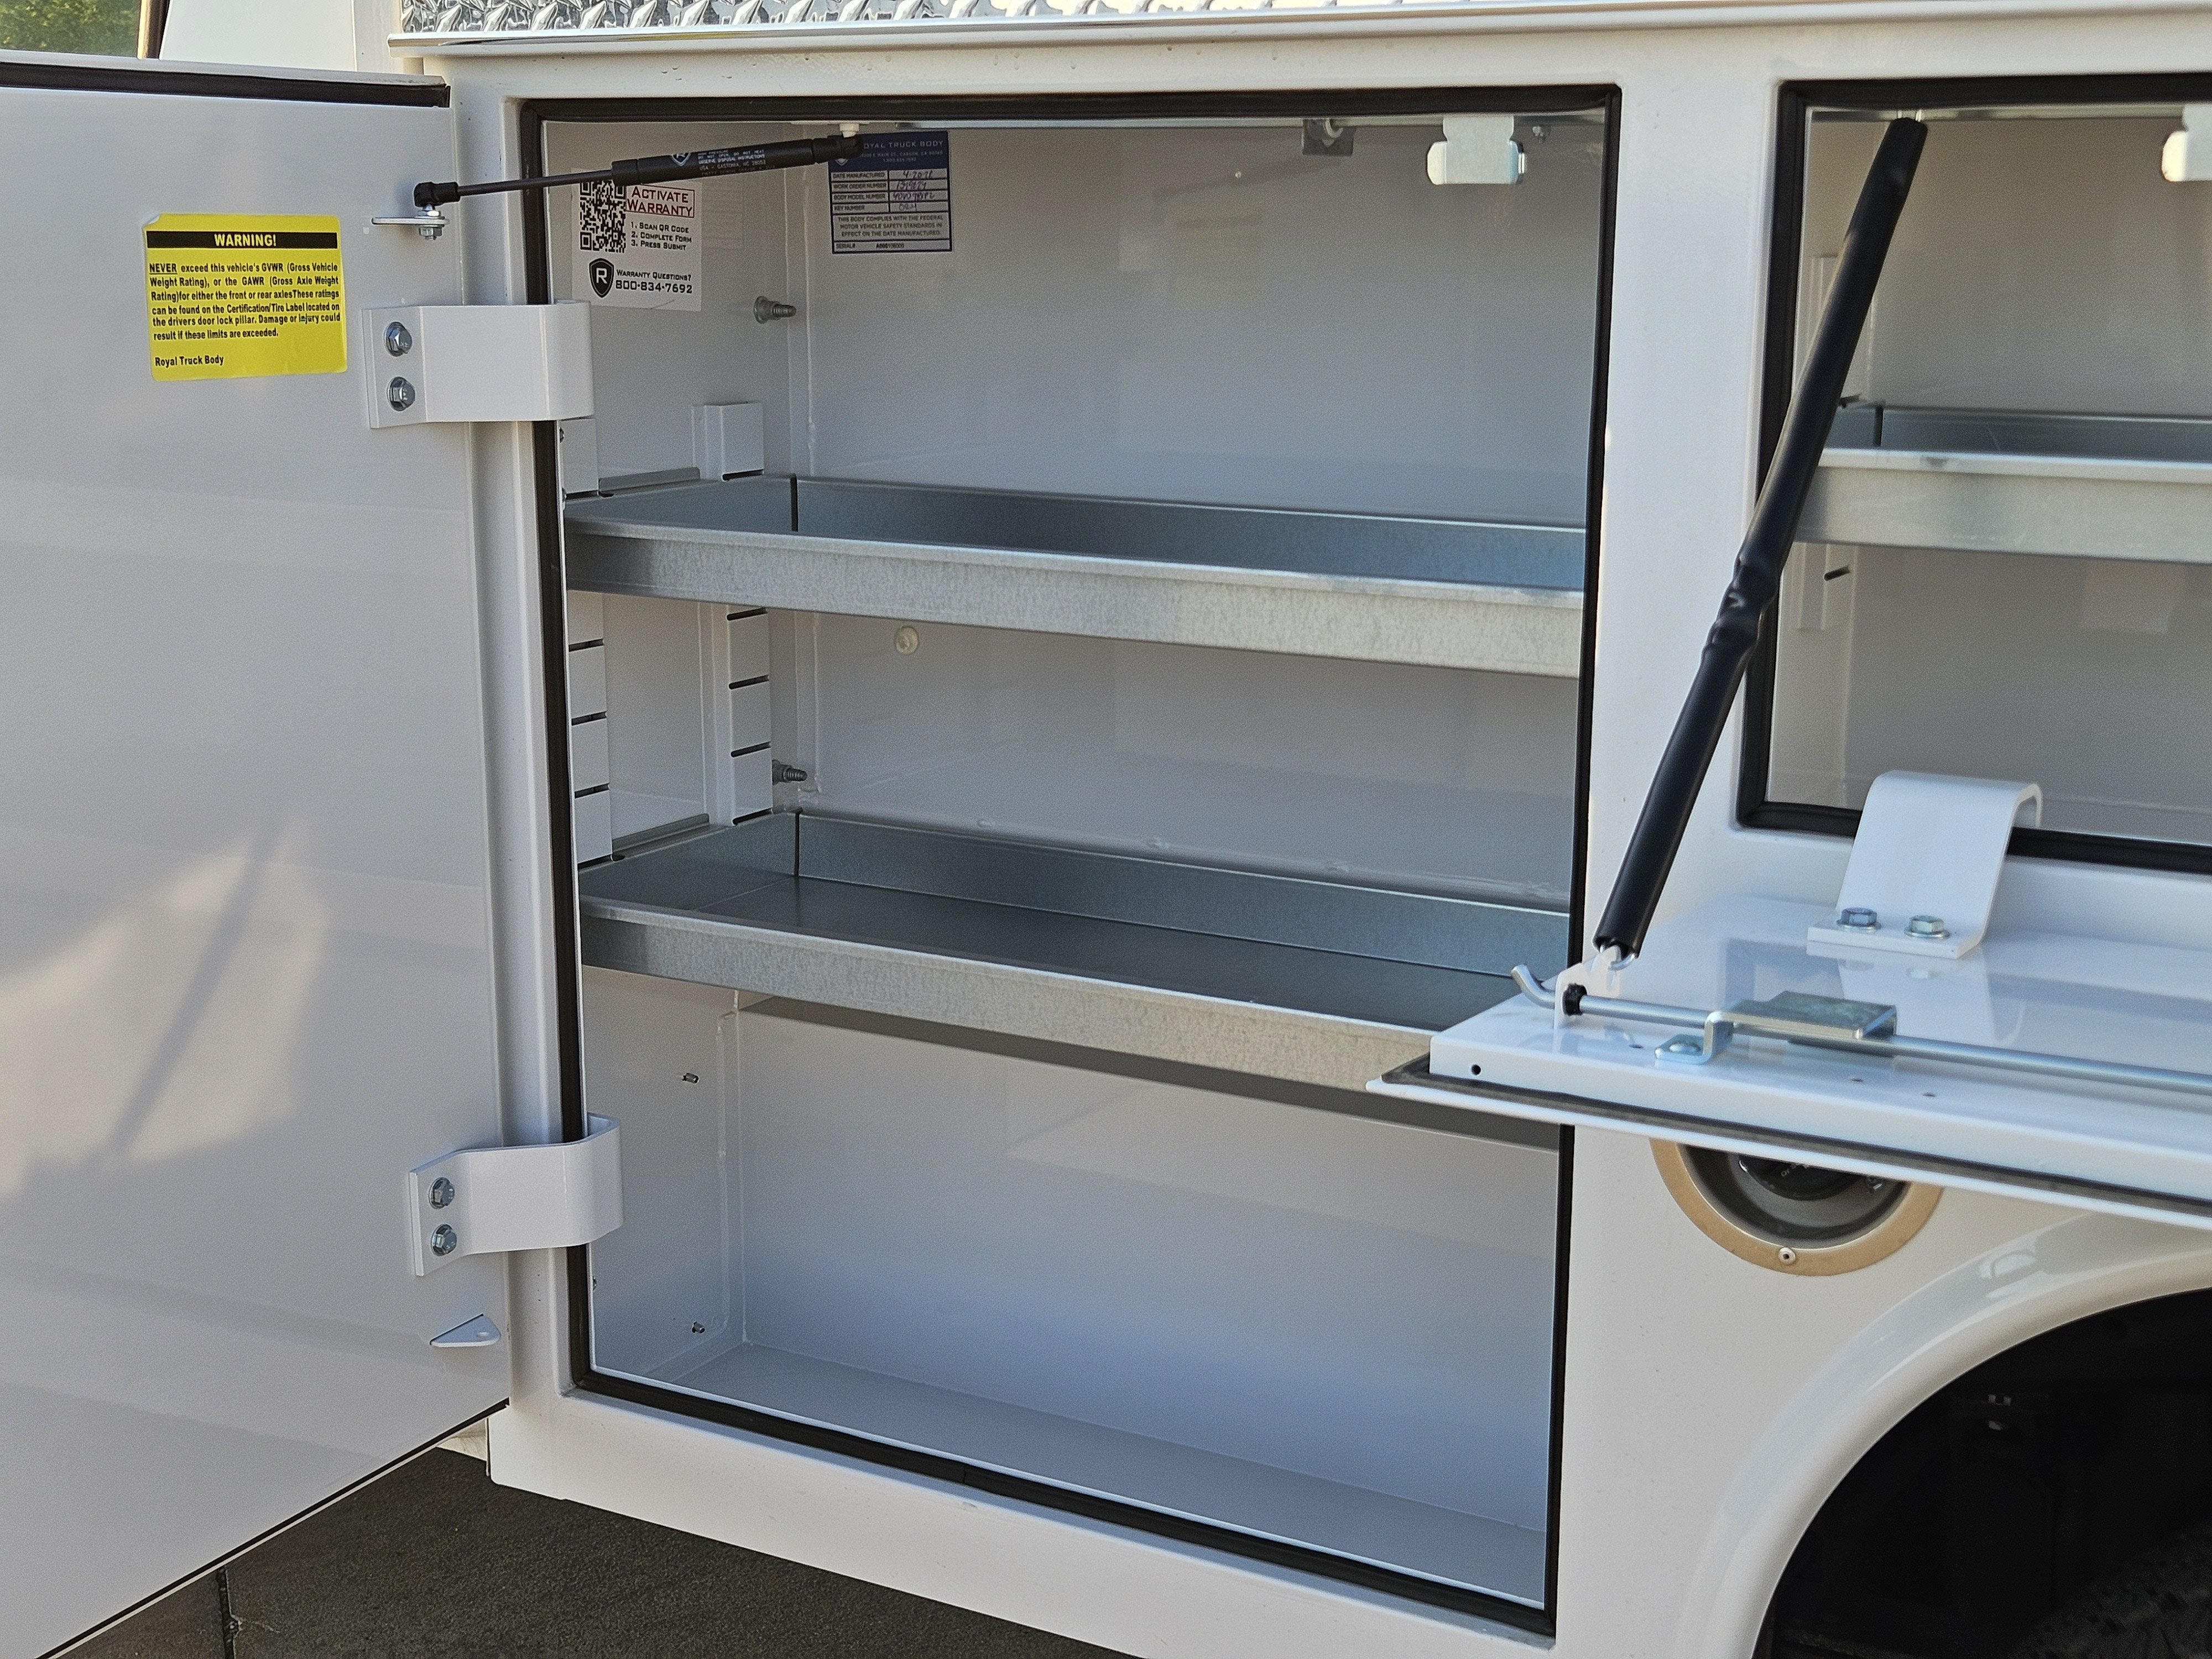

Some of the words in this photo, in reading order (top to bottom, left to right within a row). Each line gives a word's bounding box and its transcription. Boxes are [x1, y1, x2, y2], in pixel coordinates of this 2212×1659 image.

[632, 186, 688, 203] ACTIVATE
[627, 199, 692, 217] WARRANTY
[639, 222, 658, 231] SCAN
[215, 234, 276, 247] WARNING!
[640, 232, 672, 241] COMPLETE
[149, 263, 177, 274] NEVER
[181, 264, 208, 273] exceed
[211, 263, 225, 273] this
[227, 263, 259, 272] vehicle's
[262, 263, 283, 272] GVWR
[287, 263, 310, 273] (Gross
[312, 263, 338, 272] Vehicle
[616, 269, 650, 278] WARRANTY
[653, 272, 691, 281] QUESTIONS?
[150, 276, 178, 289] Weight
[179, 277, 210, 289] Rating),
[225, 276, 237, 286] the
[242, 276, 264, 285] GAWR
[270, 276, 293, 286] (Gross
[297, 276, 312, 285] Axle
[315, 276, 338, 286] Weight
[191, 291, 213, 300] either
[215, 290, 227, 300] the
[229, 290, 246, 299] front
[315, 289, 339, 300] ratings
[152, 306, 166, 315] can
[168, 306, 178, 315] be
[179, 305, 200, 314] found
[212, 305, 225, 314] the
[227, 303, 284, 314] Certification/Tire
[286, 303, 305, 312] Label
[306, 303, 330, 312] located
[153, 317, 166, 327] the
[168, 316, 196, 326] drivers
[197, 316, 215, 325] door
[217, 315, 233, 325] lock
[235, 315, 257, 326] pillar.
[259, 315, 288, 325] Damage
[299, 314, 319, 325] injury
[321, 312, 340, 322] could
[154, 331, 176, 341] result
[178, 331, 182, 340] if
[185, 331, 205, 340] these
[207, 330, 228, 339] limits
[242, 327, 279, 338] exceeded.
[155, 355, 178, 368] Royal
[179, 355, 202, 365] Truck
[205, 354, 224, 366] Body
